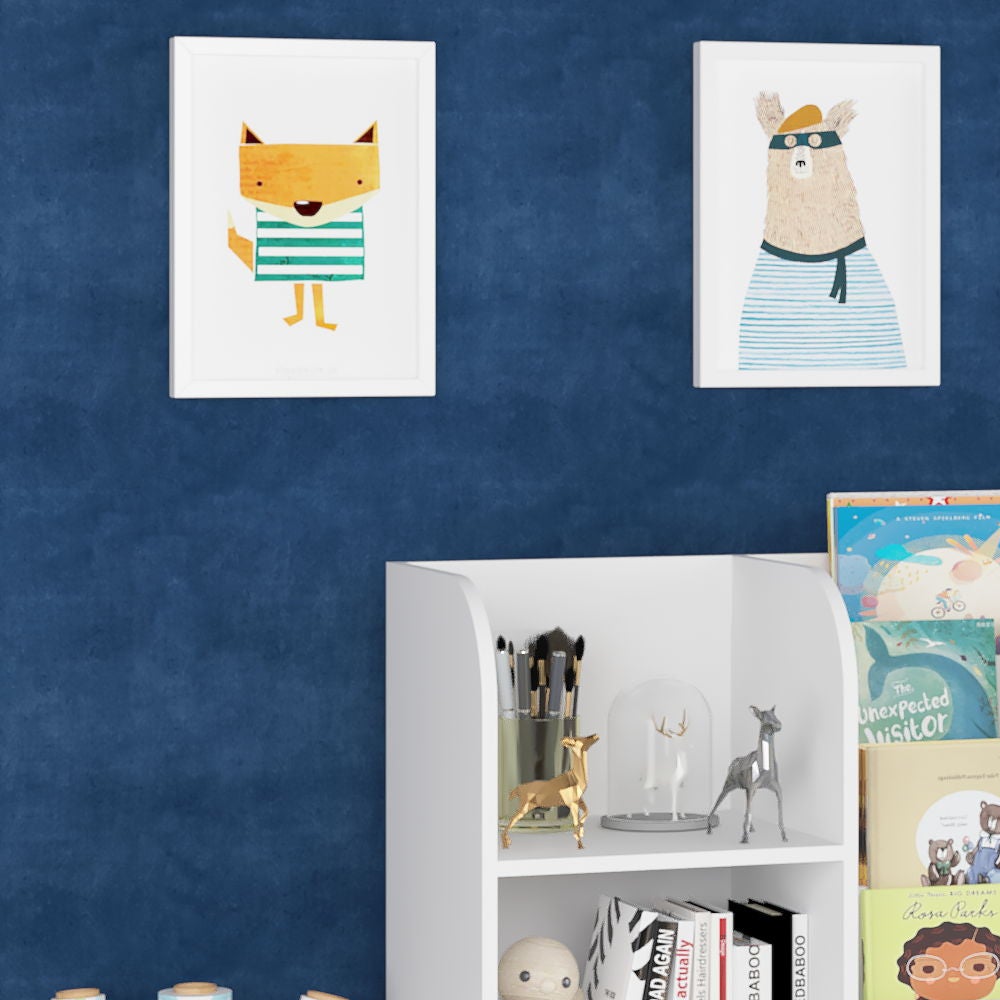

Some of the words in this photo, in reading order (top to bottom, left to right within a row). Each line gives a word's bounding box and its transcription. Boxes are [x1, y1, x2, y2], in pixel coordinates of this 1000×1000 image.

[893, 683, 914, 694] The
[902, 901, 948, 920] Rosa
[950, 899, 999, 919] Parks
[653, 929, 675, 979] AGAIN
[676, 940, 694, 998] actually
[698, 922, 708, 986] Hairdressers
